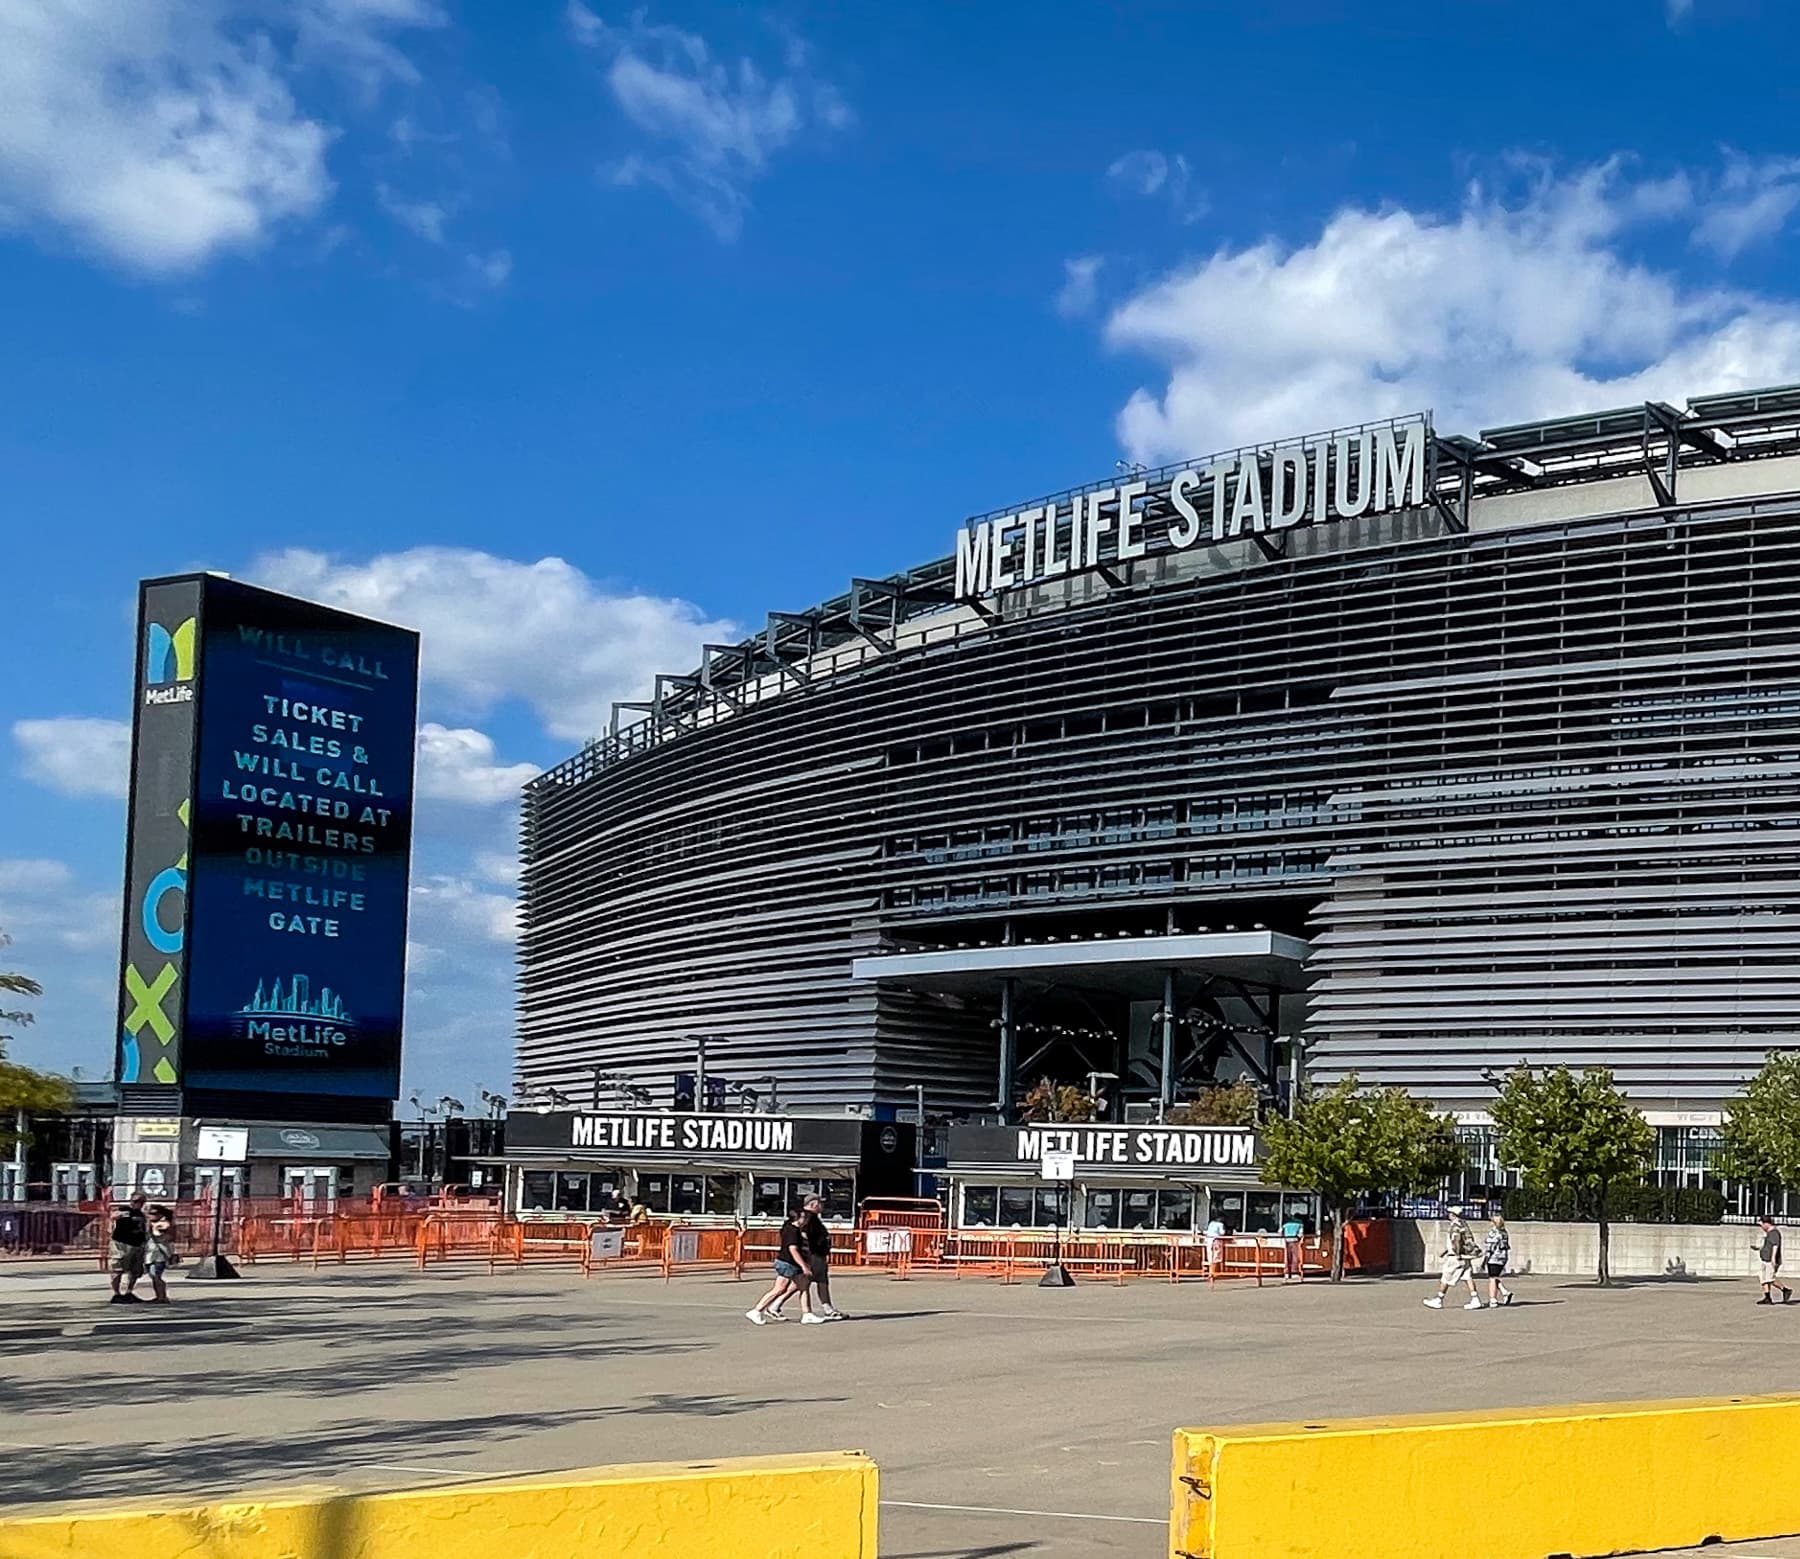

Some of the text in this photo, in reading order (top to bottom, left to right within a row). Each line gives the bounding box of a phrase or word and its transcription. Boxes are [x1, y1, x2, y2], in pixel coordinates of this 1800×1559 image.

[954, 422, 1426, 598] METLIFE STADIUM
[238, 624, 389, 679] WILL CALL
[145, 685, 193, 704] MetLife
[264, 695, 363, 732] TICKET
[252, 724, 368, 765] SALES &
[234, 750, 383, 796] WILL CALL
[222, 780, 391, 826] LOCATED AT
[237, 814, 375, 853] TRAILERS
[245, 847, 366, 881] OUTSIDE
[243, 878, 366, 911] METLIFE
[269, 912, 339, 937] GATE
[247, 1021, 346, 1045] MetLife
[264, 1042, 329, 1058] Stadium
[572, 1116, 793, 1151] METLIFE STADIUM
[1017, 1131, 1254, 1165] METLIFE STADIUM
